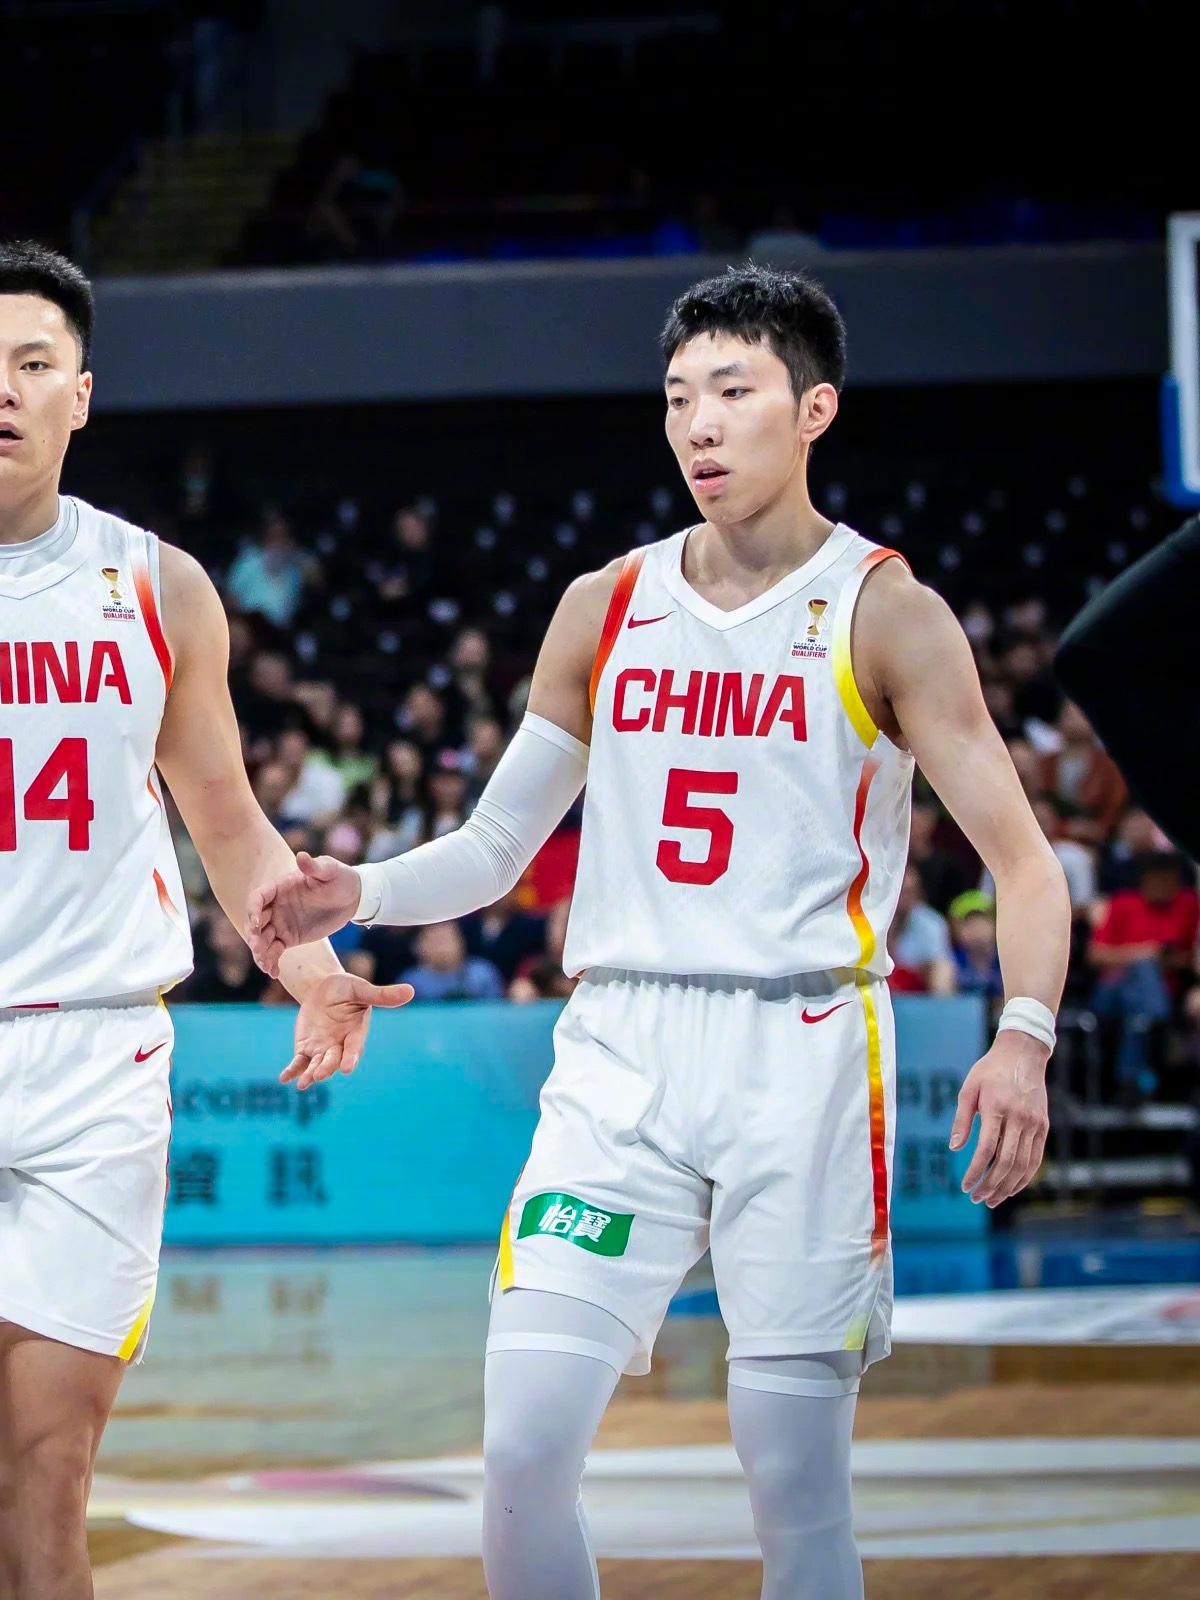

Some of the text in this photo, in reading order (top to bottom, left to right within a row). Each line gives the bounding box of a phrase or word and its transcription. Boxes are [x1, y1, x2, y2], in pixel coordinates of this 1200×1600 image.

[791, 649, 827, 659] QUALIFIERS
[612, 668, 808, 742] CHINA
[656, 767, 739, 886] 5
[172, 1076, 331, 1128] comp
[538, 1203, 612, 1243] 怡寶
